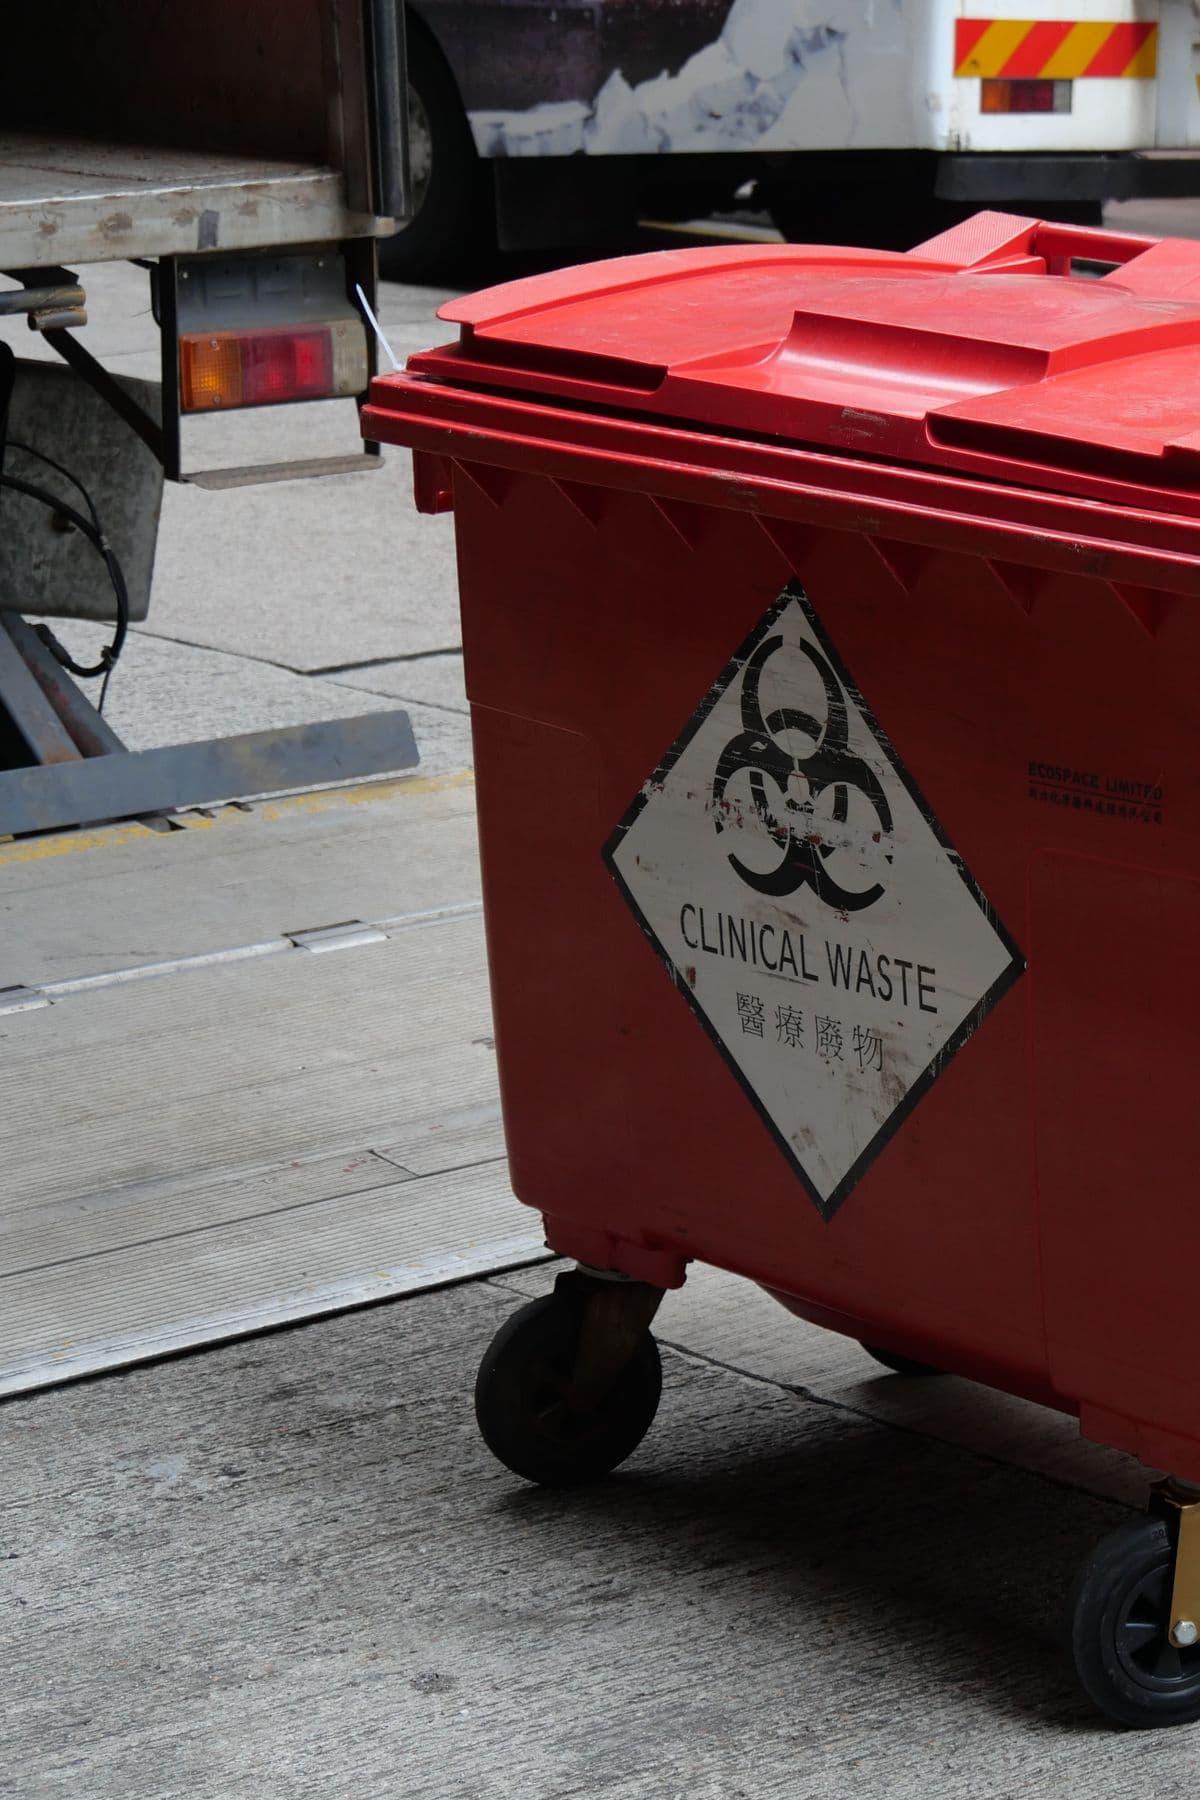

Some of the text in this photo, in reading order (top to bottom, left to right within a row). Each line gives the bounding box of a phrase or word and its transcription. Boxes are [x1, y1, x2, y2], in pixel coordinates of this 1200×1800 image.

[1028, 760, 1163, 801] ECOSPACE LIMITED
[680, 903, 938, 1014] CLINICAL WASTE
[736, 991, 884, 1072] 醫療廢物
